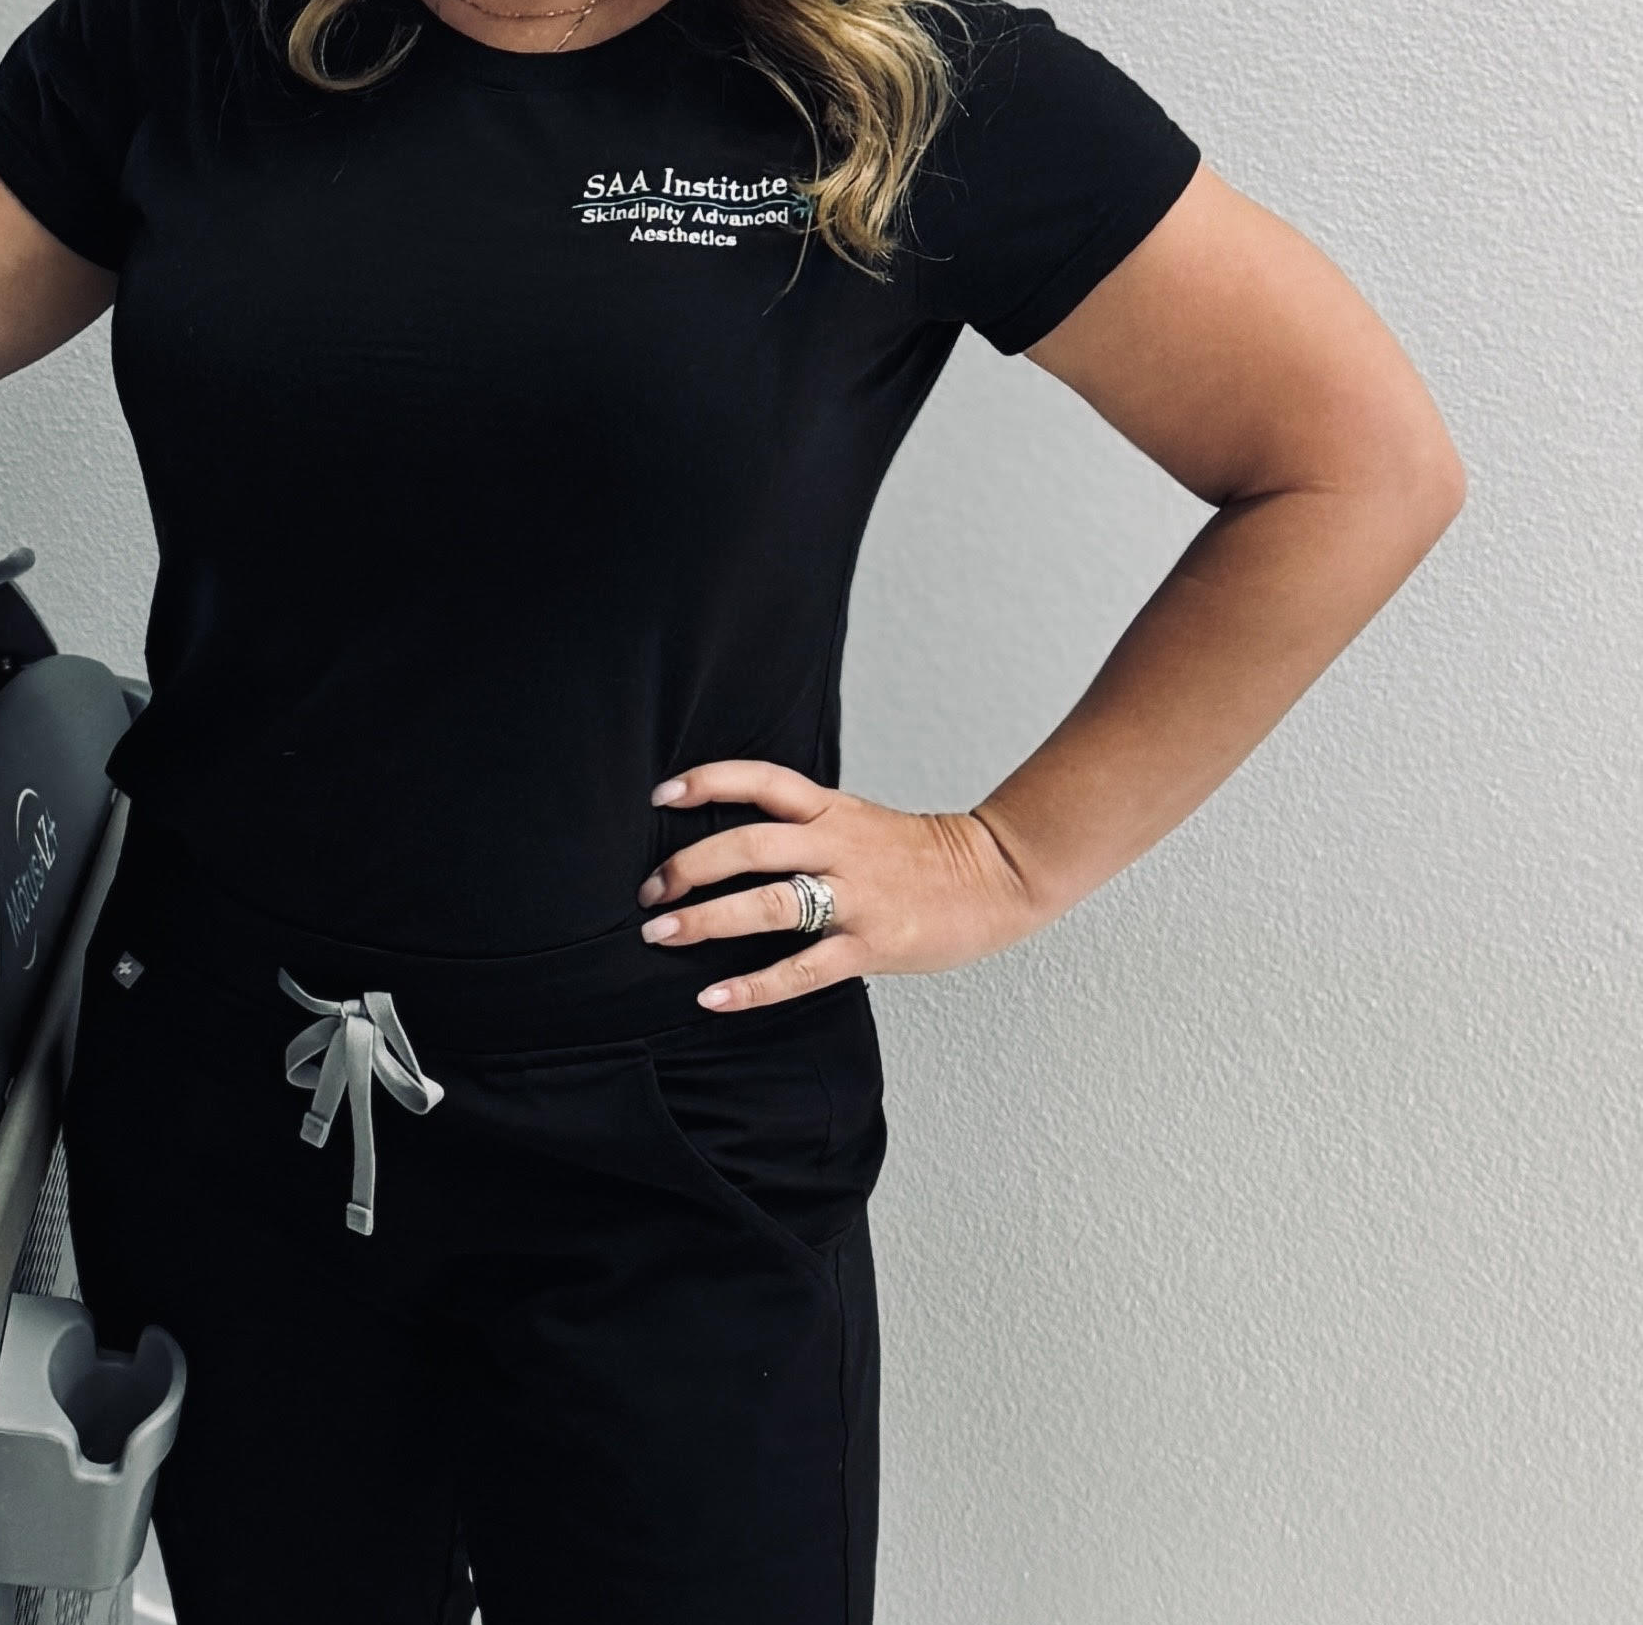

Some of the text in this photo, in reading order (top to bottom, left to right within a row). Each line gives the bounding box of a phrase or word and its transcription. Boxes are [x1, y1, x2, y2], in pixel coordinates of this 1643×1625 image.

[583, 167, 789, 203] SAA Institute
[691, 205, 790, 227] Advanced
[629, 225, 738, 248] Aesthetics
